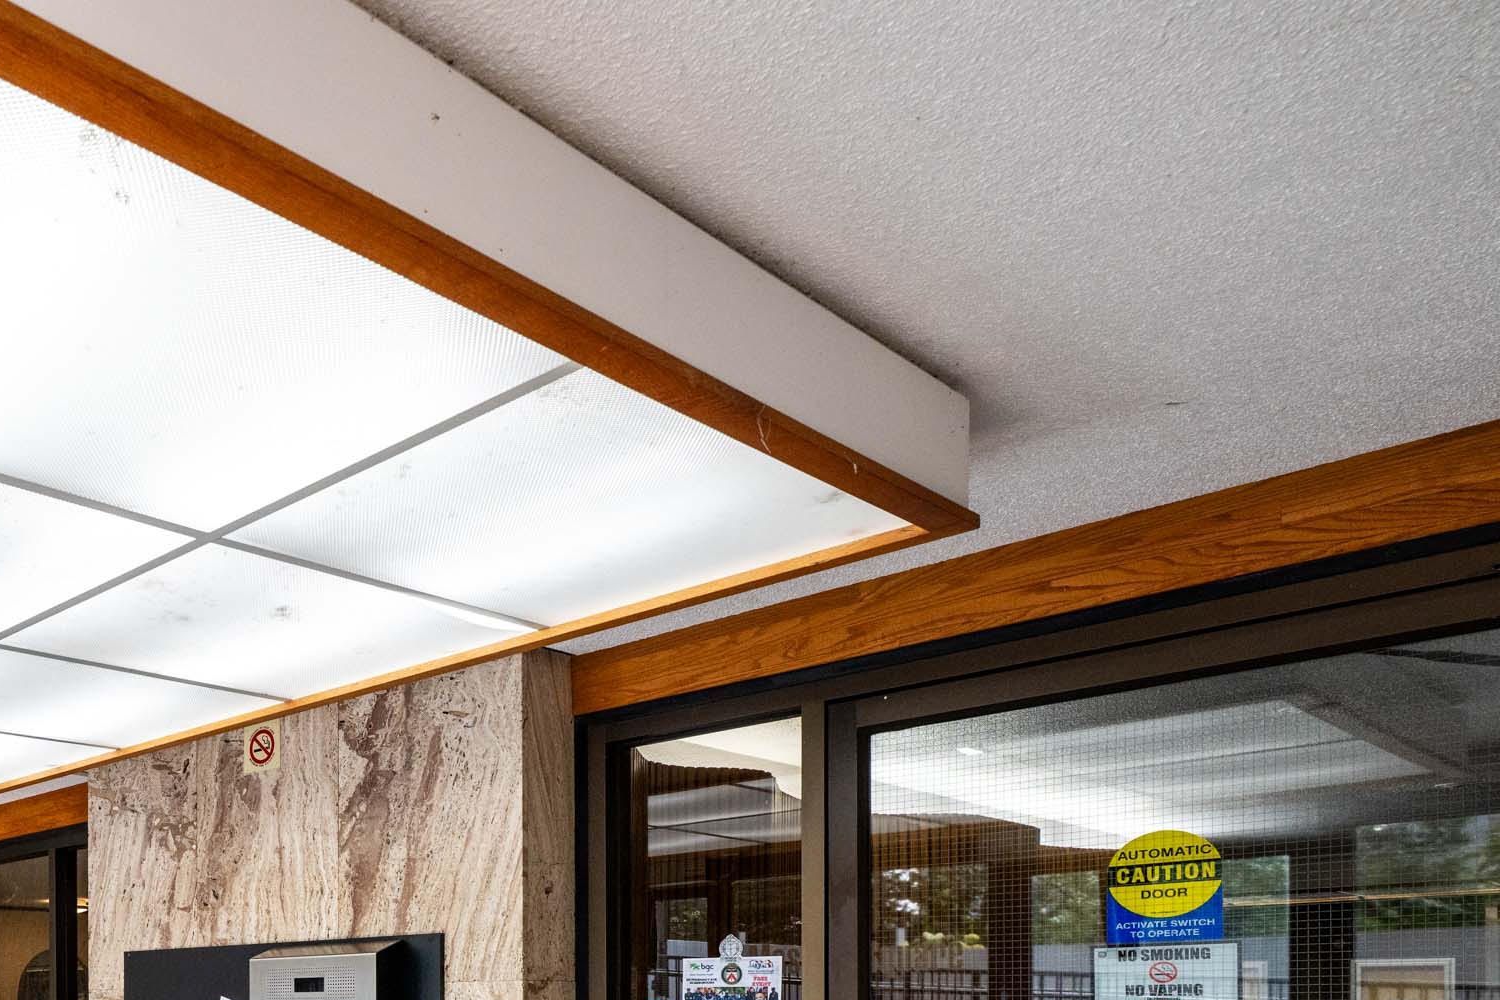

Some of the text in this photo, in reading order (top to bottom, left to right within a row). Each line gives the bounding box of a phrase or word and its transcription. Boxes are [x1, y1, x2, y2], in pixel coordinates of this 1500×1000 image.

[1118, 844, 1212, 861] AUTOMATIC
[1116, 861, 1216, 884] CAUTION
[1141, 888, 1188, 899] DOOR
[1115, 918, 1215, 930] ACTIVATE SWITCH
[1130, 928, 1200, 938] TO OPERATE
[1118, 947, 1211, 962] NO SMOKING
[701, 963, 714, 972] bgc
[1125, 983, 1204, 996] NO VAPING
